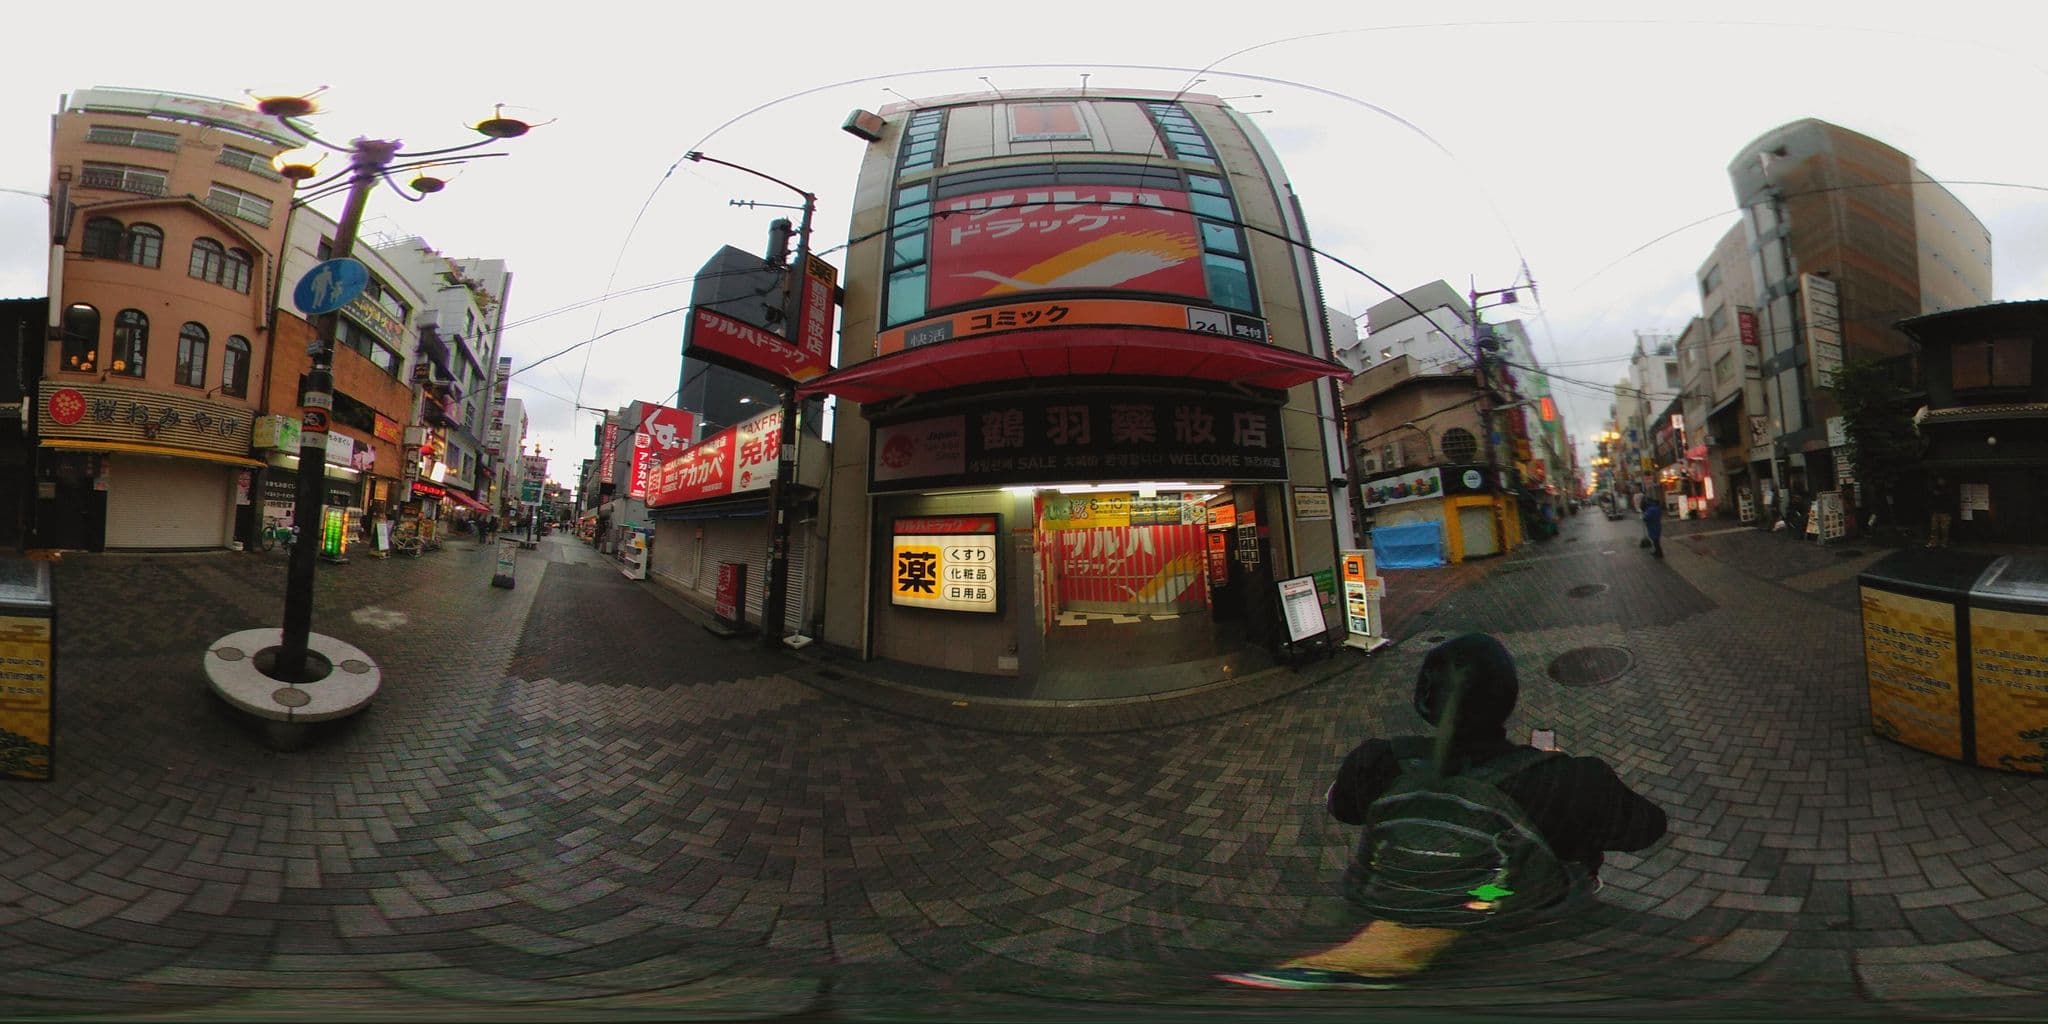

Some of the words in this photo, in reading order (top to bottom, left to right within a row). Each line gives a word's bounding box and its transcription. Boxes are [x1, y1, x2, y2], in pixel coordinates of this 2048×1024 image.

[950, 191, 1175, 221] ツルハ
[951, 214, 1126, 246] ドラッグ
[971, 305, 1069, 331] コミック
[700, 312, 810, 363] ツルハドラッグ
[94, 399, 239, 439] 桜おみやげ
[637, 452, 648, 489] アカカベ
[679, 453, 725, 490] アカカベ
[1018, 456, 1057, 470] SALE
[1170, 453, 1240, 467] WELCOME
[951, 549, 986, 560] くすり
[1063, 528, 1155, 558] ツルハ
[898, 551, 936, 594] 薬
[951, 568, 987, 580] 化粧品
[951, 587, 987, 599] 日用品
